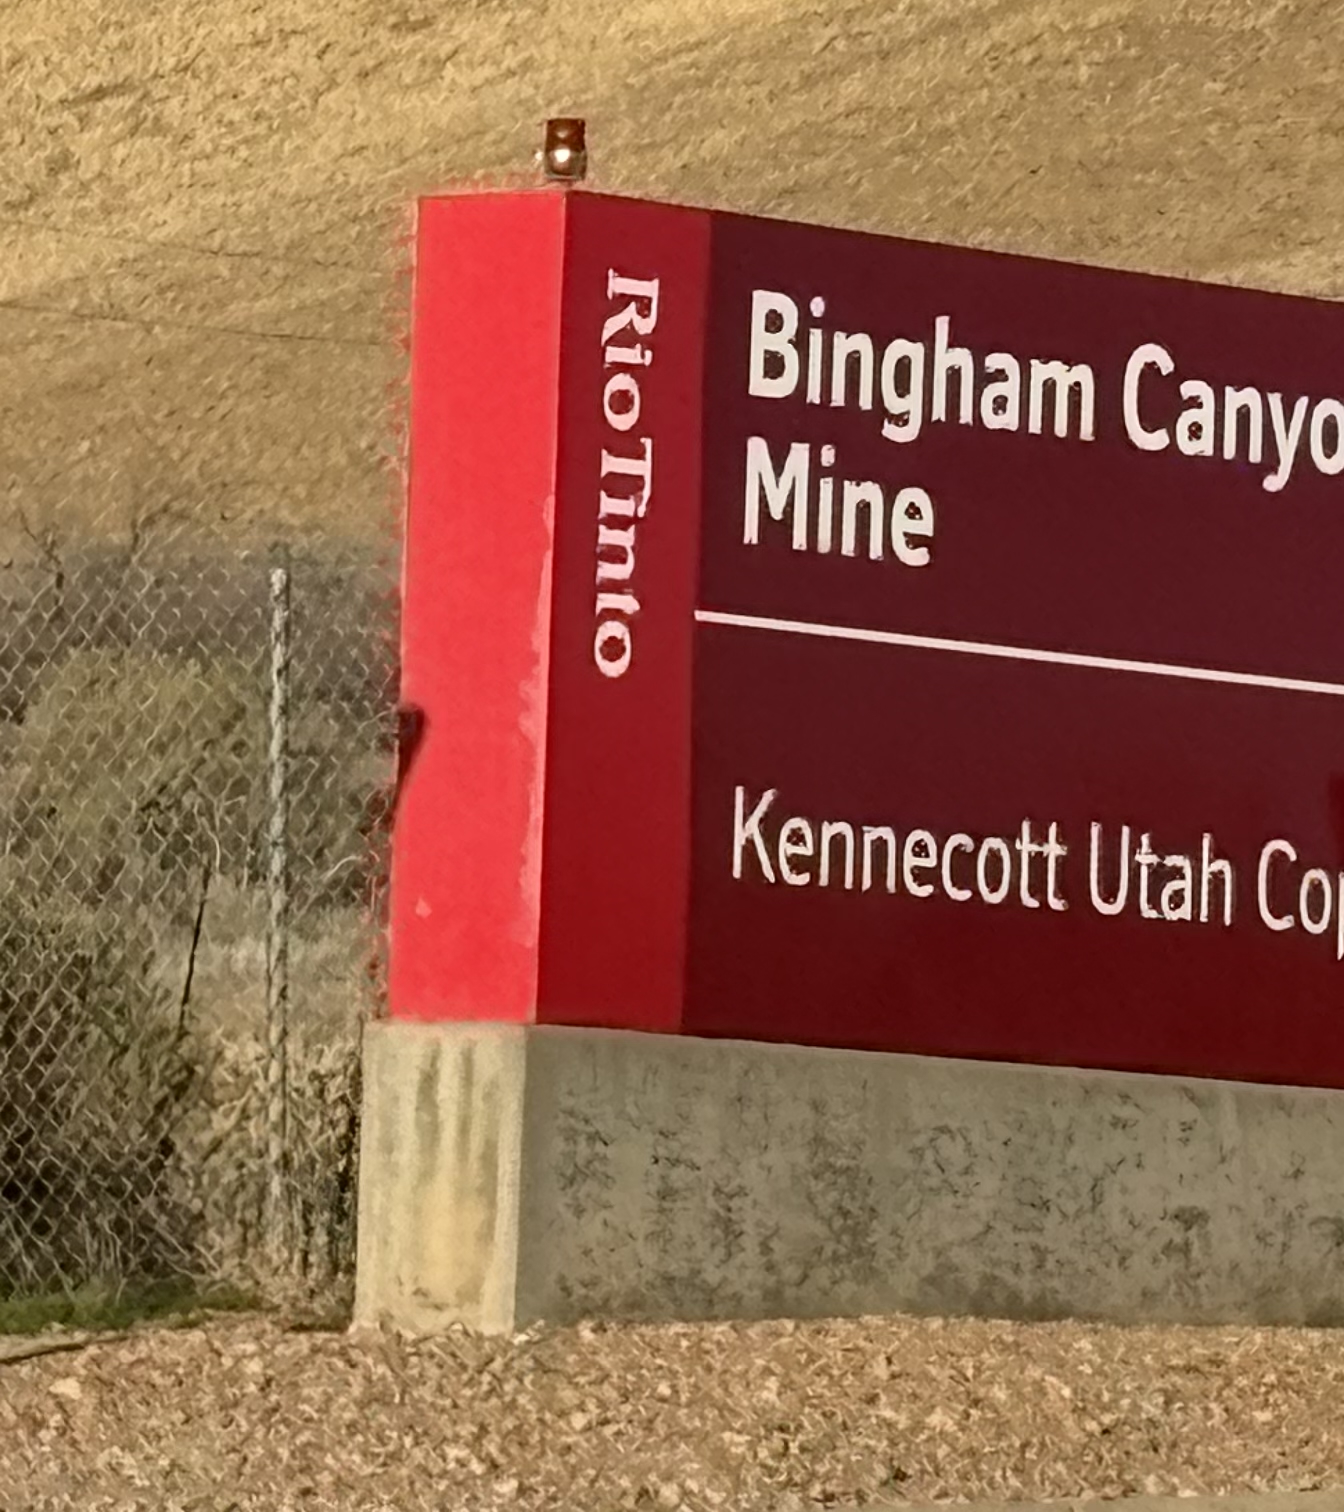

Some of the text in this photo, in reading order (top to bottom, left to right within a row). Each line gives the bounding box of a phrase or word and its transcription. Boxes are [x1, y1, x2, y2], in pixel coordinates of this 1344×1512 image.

[747, 290, 1095, 443] Bingham
[595, 269, 659, 677] Rio Tinto
[744, 437, 935, 567] Mine
[733, 786, 1068, 910] Kennecott
[1090, 822, 1232, 926] Utah
